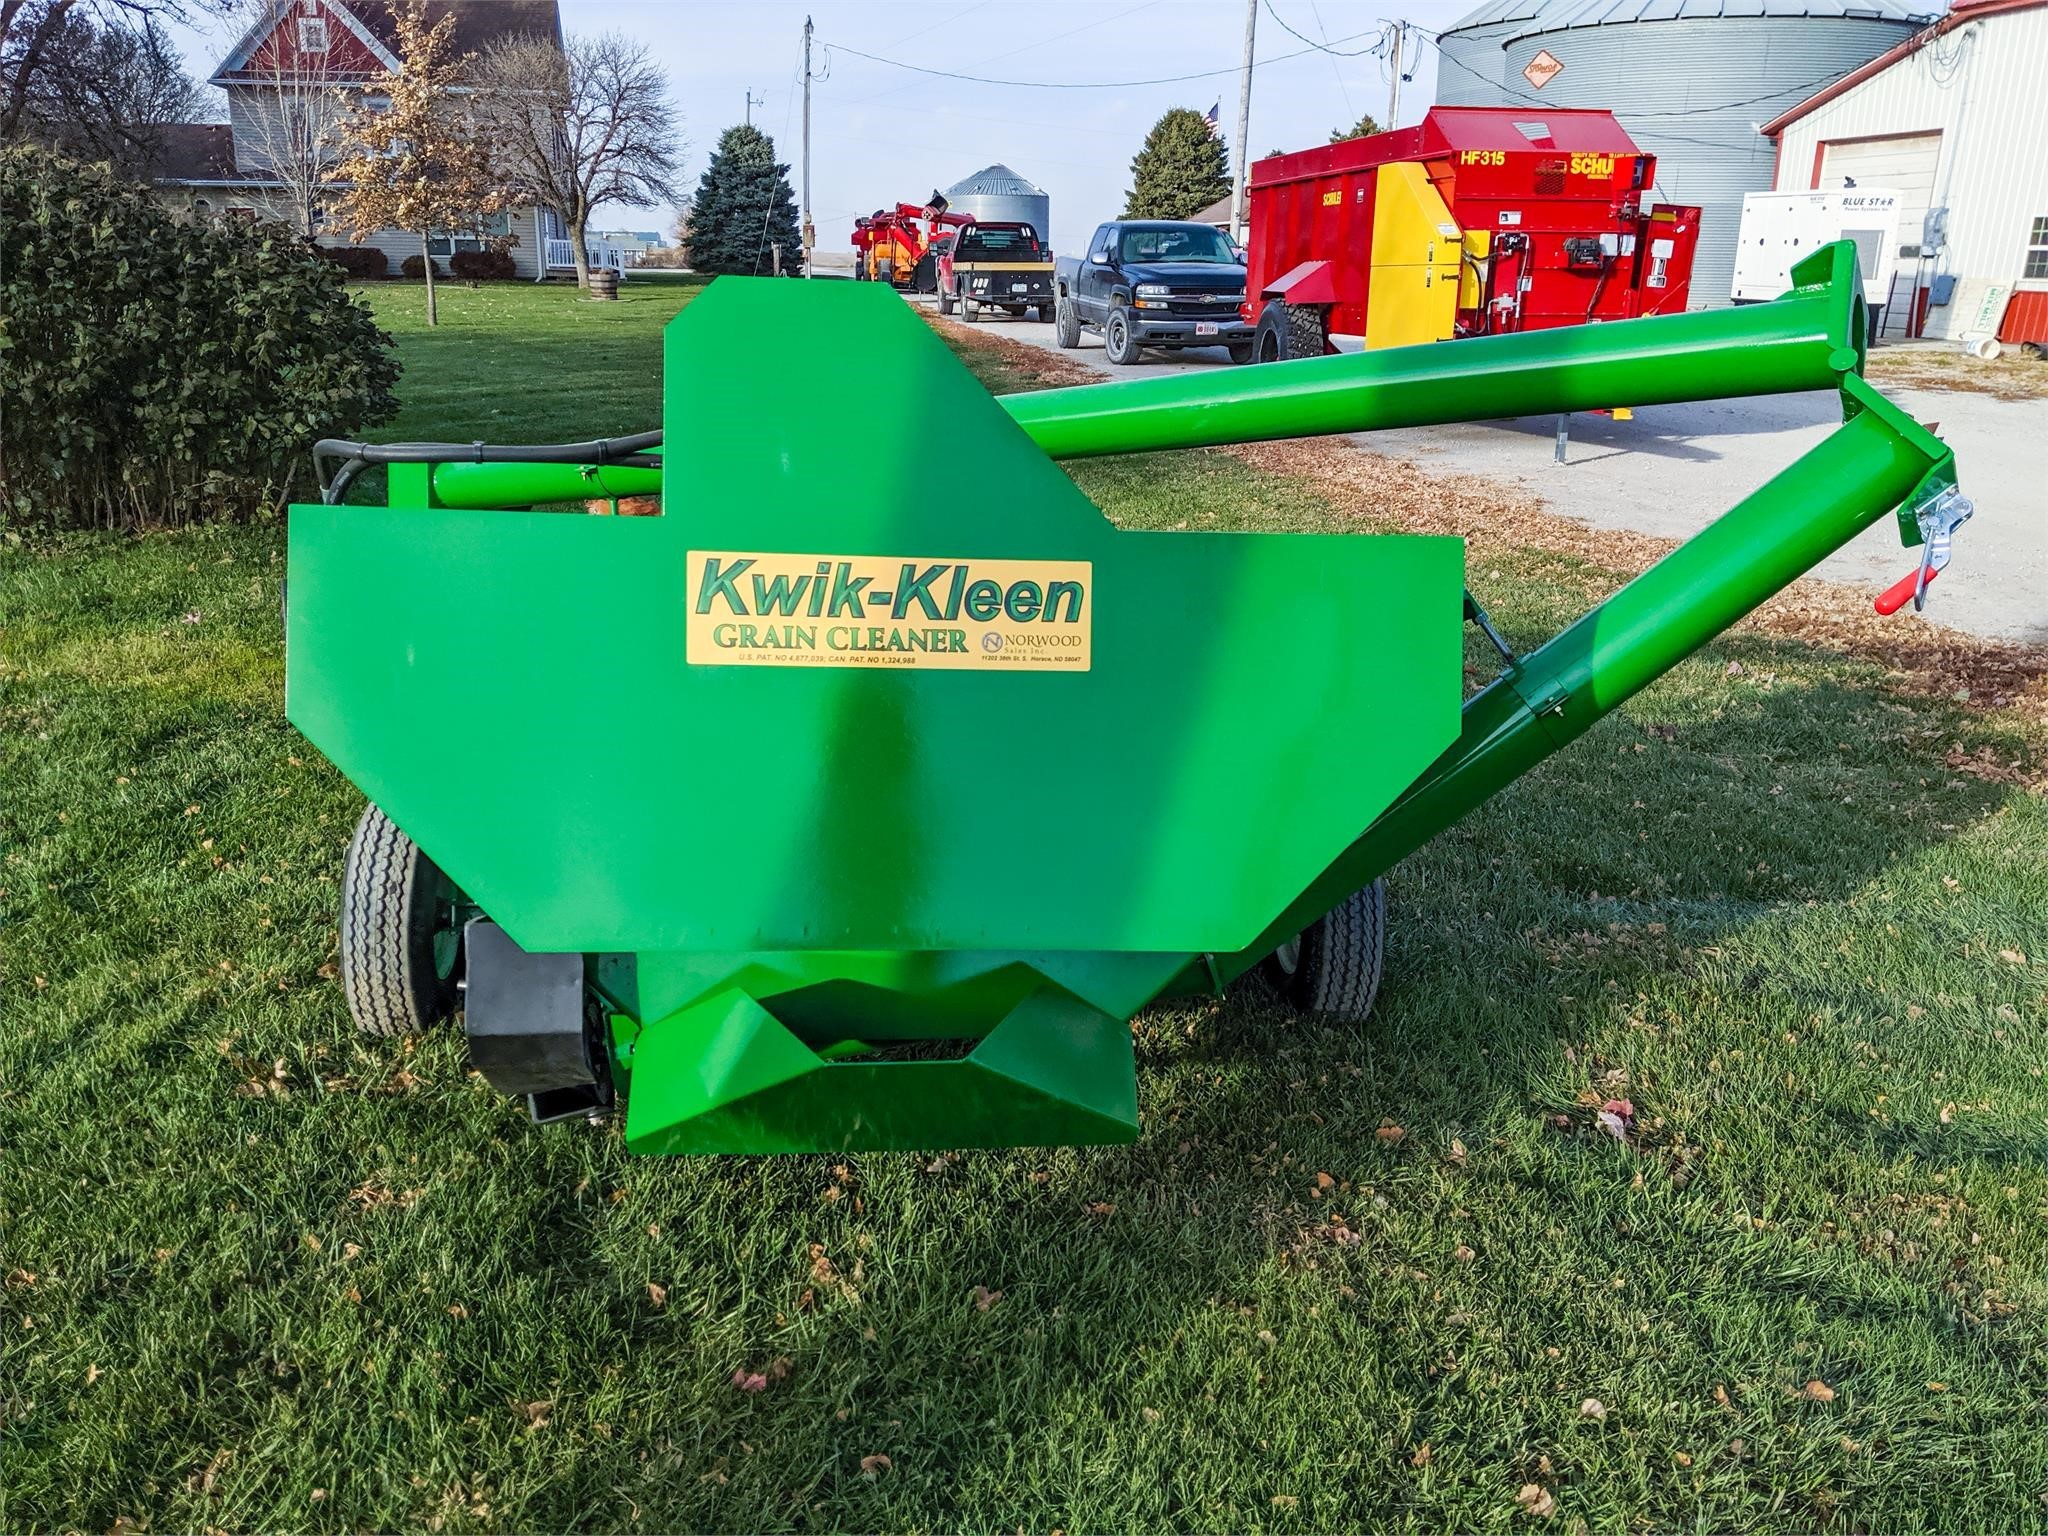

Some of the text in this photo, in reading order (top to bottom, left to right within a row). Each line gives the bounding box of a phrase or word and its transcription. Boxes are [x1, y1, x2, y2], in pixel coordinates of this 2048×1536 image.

[1460, 150, 1505, 166] HF315
[1570, 157, 1615, 175] SCHU
[1842, 197, 1865, 206] BLUE
[695, 557, 1084, 624] Kwik-Kleen
[713, 623, 969, 654] GRAIN CLEANER
[1004, 634, 1083, 648] NORWOOD
[756, 654, 772, 662] PAT.
[774, 654, 787, 662] NO
[849, 656, 865, 664] PAT.
[867, 656, 879, 664] NO
